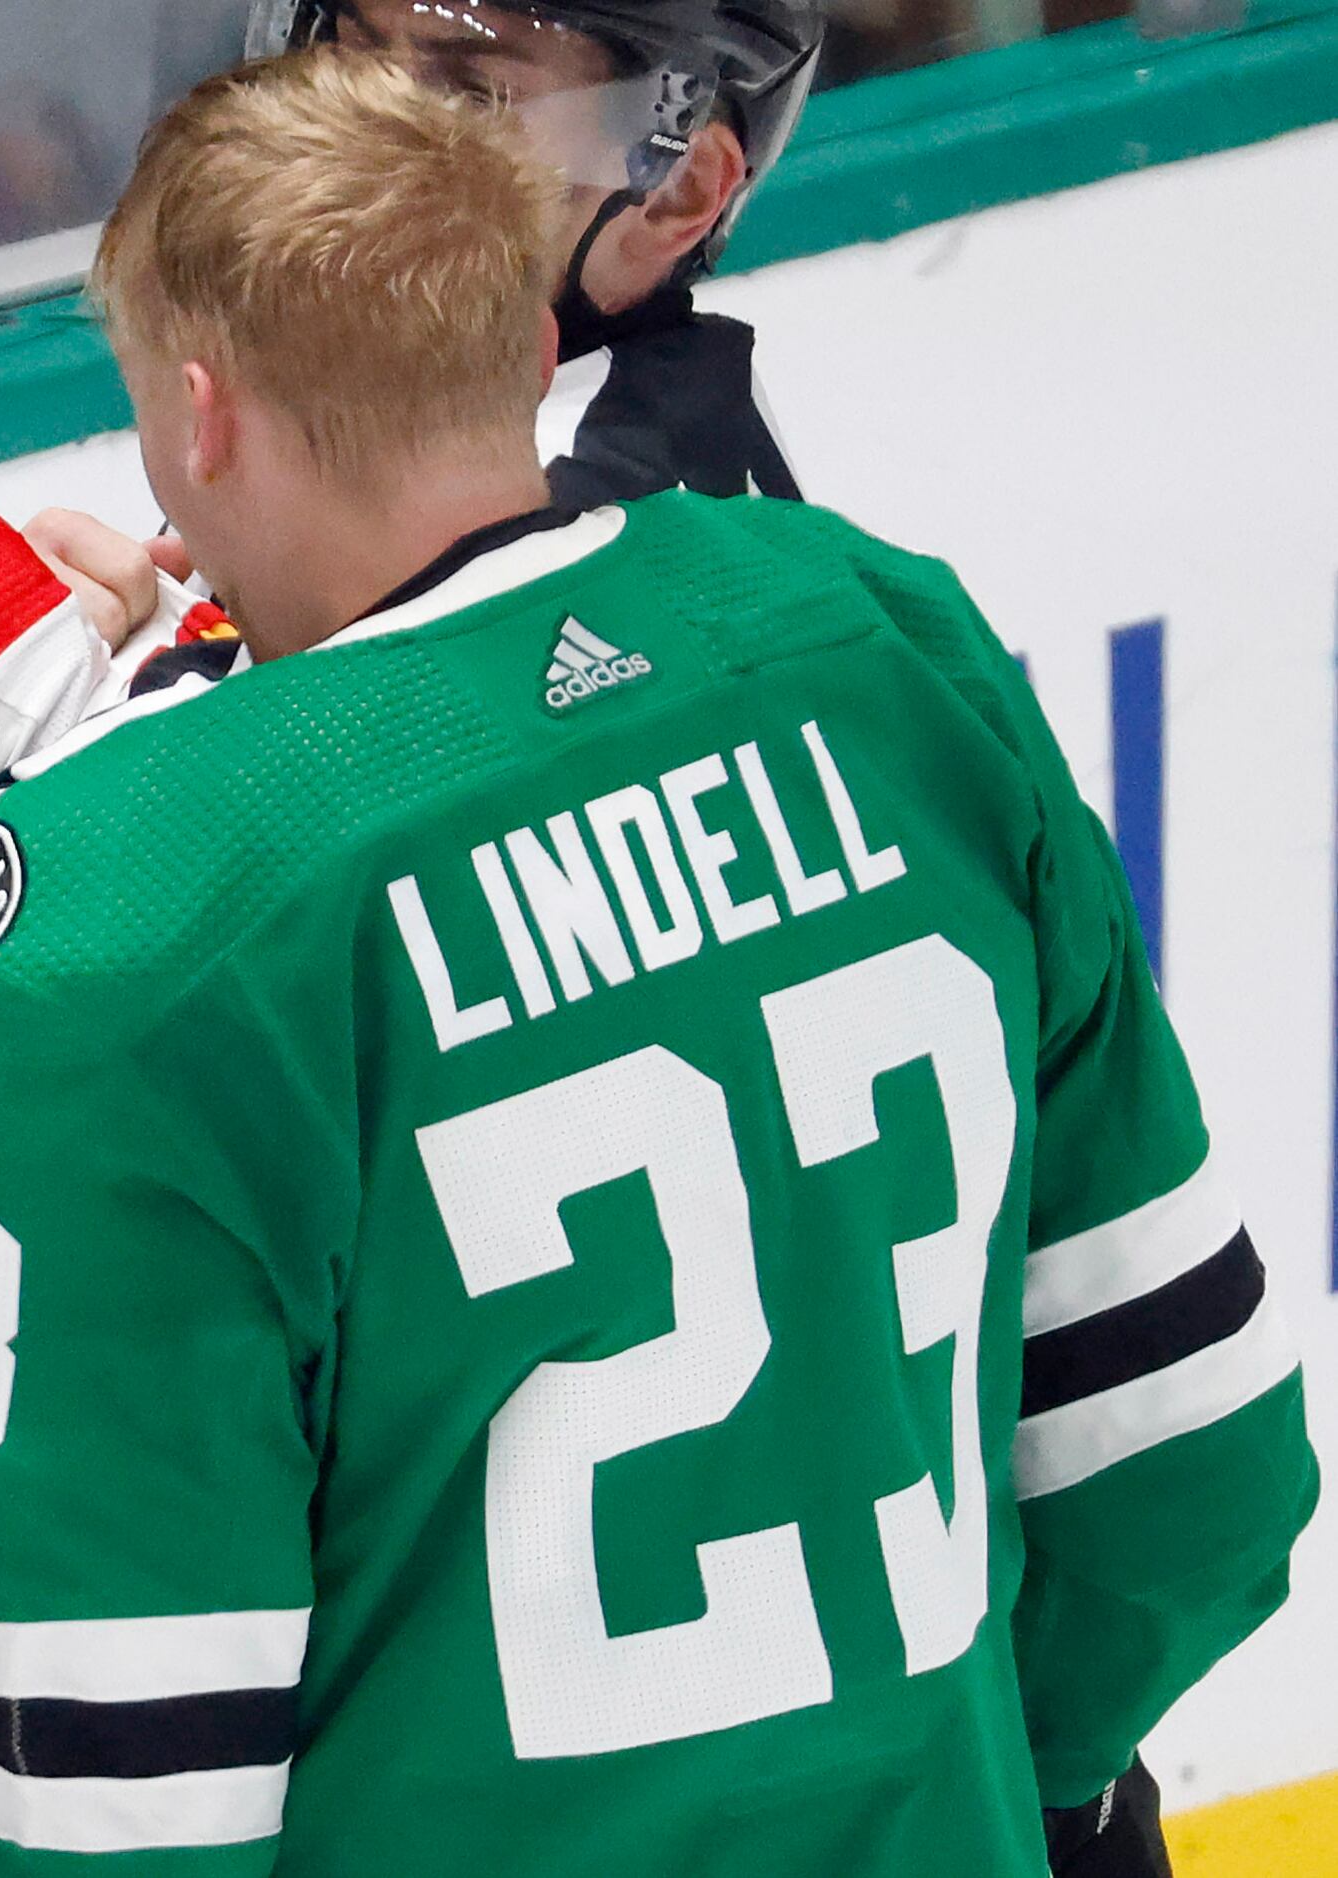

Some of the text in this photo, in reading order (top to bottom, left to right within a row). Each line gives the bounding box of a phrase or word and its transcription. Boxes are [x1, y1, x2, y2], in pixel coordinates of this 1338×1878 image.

[545, 652, 653, 708] adidas
[386, 719, 908, 1053] LINDELL
[414, 932, 1018, 1759] 23
